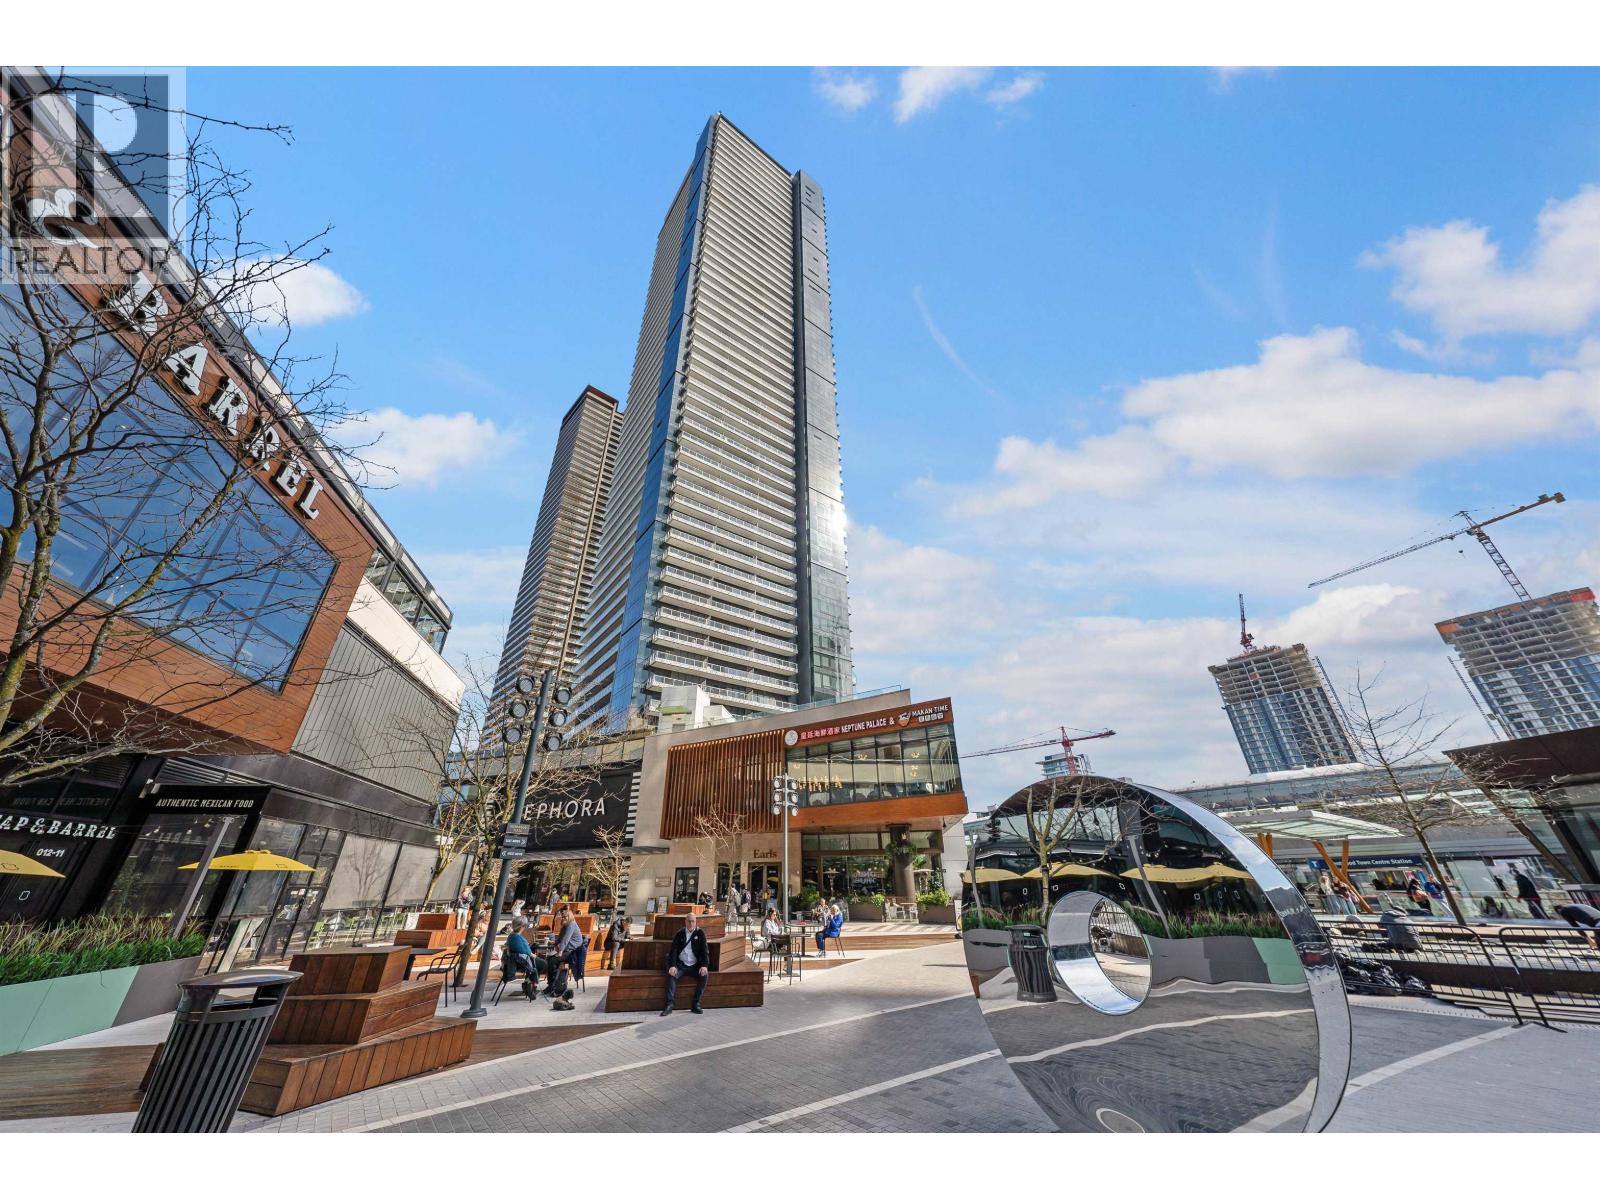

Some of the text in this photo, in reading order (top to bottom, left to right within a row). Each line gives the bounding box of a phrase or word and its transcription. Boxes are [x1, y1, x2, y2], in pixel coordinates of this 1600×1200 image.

[108, 272, 324, 520] BARREL
[841, 722, 866, 734] NEPTUNE
[866, 718, 887, 729] PALACE
[889, 717, 895, 725] &
[912, 708, 933, 717] MAKAN
[934, 704, 949, 713] TIME
[156, 798, 254, 808] AUTHENTIC MEXICAN FOOD
[523, 797, 606, 821] EPHORA
[0, 814, 117, 840] AP & BARREL
[36, 848, 65, 858] 012-11
[753, 848, 778, 859] Earls
